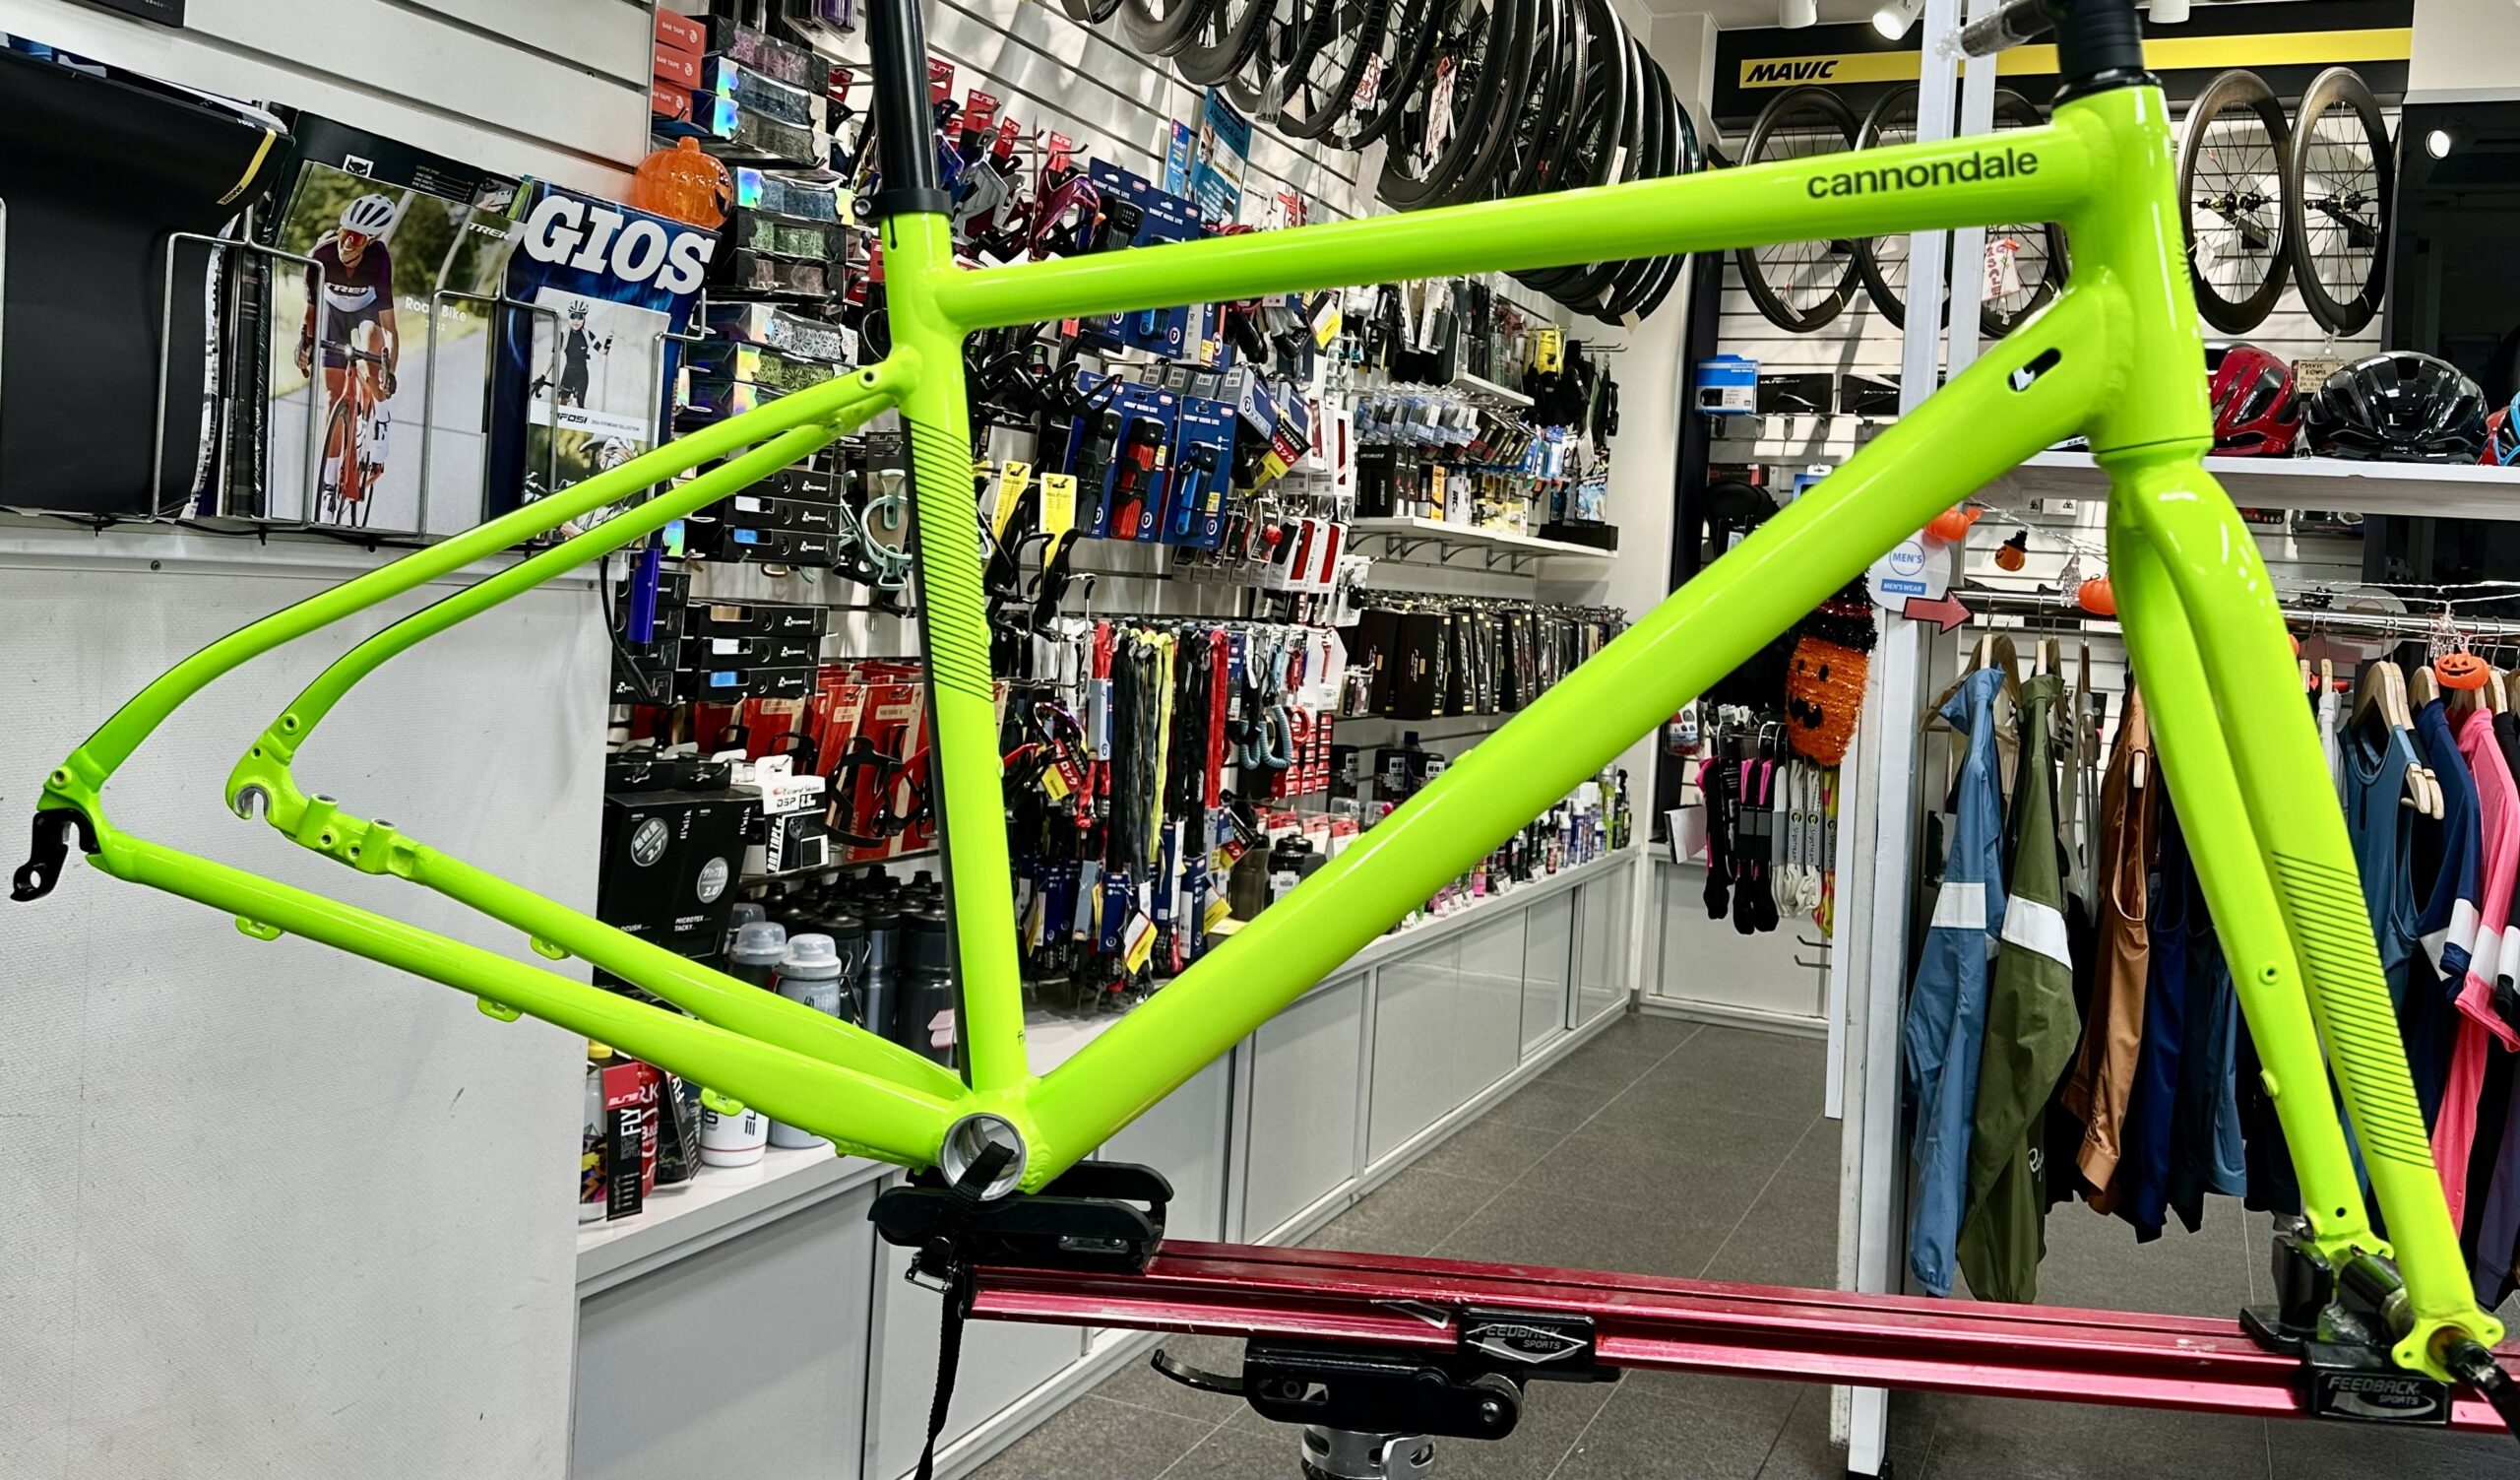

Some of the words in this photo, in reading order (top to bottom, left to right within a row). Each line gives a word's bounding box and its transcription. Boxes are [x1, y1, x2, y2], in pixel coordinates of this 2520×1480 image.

[662, 22, 672, 31] BAR
[672, 26, 685, 36] TAPE
[656, 55, 666, 64] BAR
[667, 59, 680, 70] TAPE
[1745, 59, 1839, 83] MAVIC
[660, 93, 672, 102] TAPE
[1806, 147, 2039, 199] cannondale
[469, 222, 512, 241] TREK
[523, 195, 717, 294] GIOS
[405, 296, 435, 315] Roa
[441, 304, 468, 323] Bike
[1892, 552, 1922, 564] MEN'S
[777, 797, 796, 807] DSP
[770, 826, 783, 850] TAPE
[767, 850, 779, 871] BAR
[674, 915, 704, 925] MICROTEX
[674, 924, 694, 933] TACKY
[607, 1091, 640, 1107] ELITE
[620, 1108, 642, 1137] FLY
[1523, 1339, 1561, 1350] SPORTS
[2327, 1376, 2422, 1395] FEEDBACK
[2378, 1393, 2419, 1406] SPORTS
